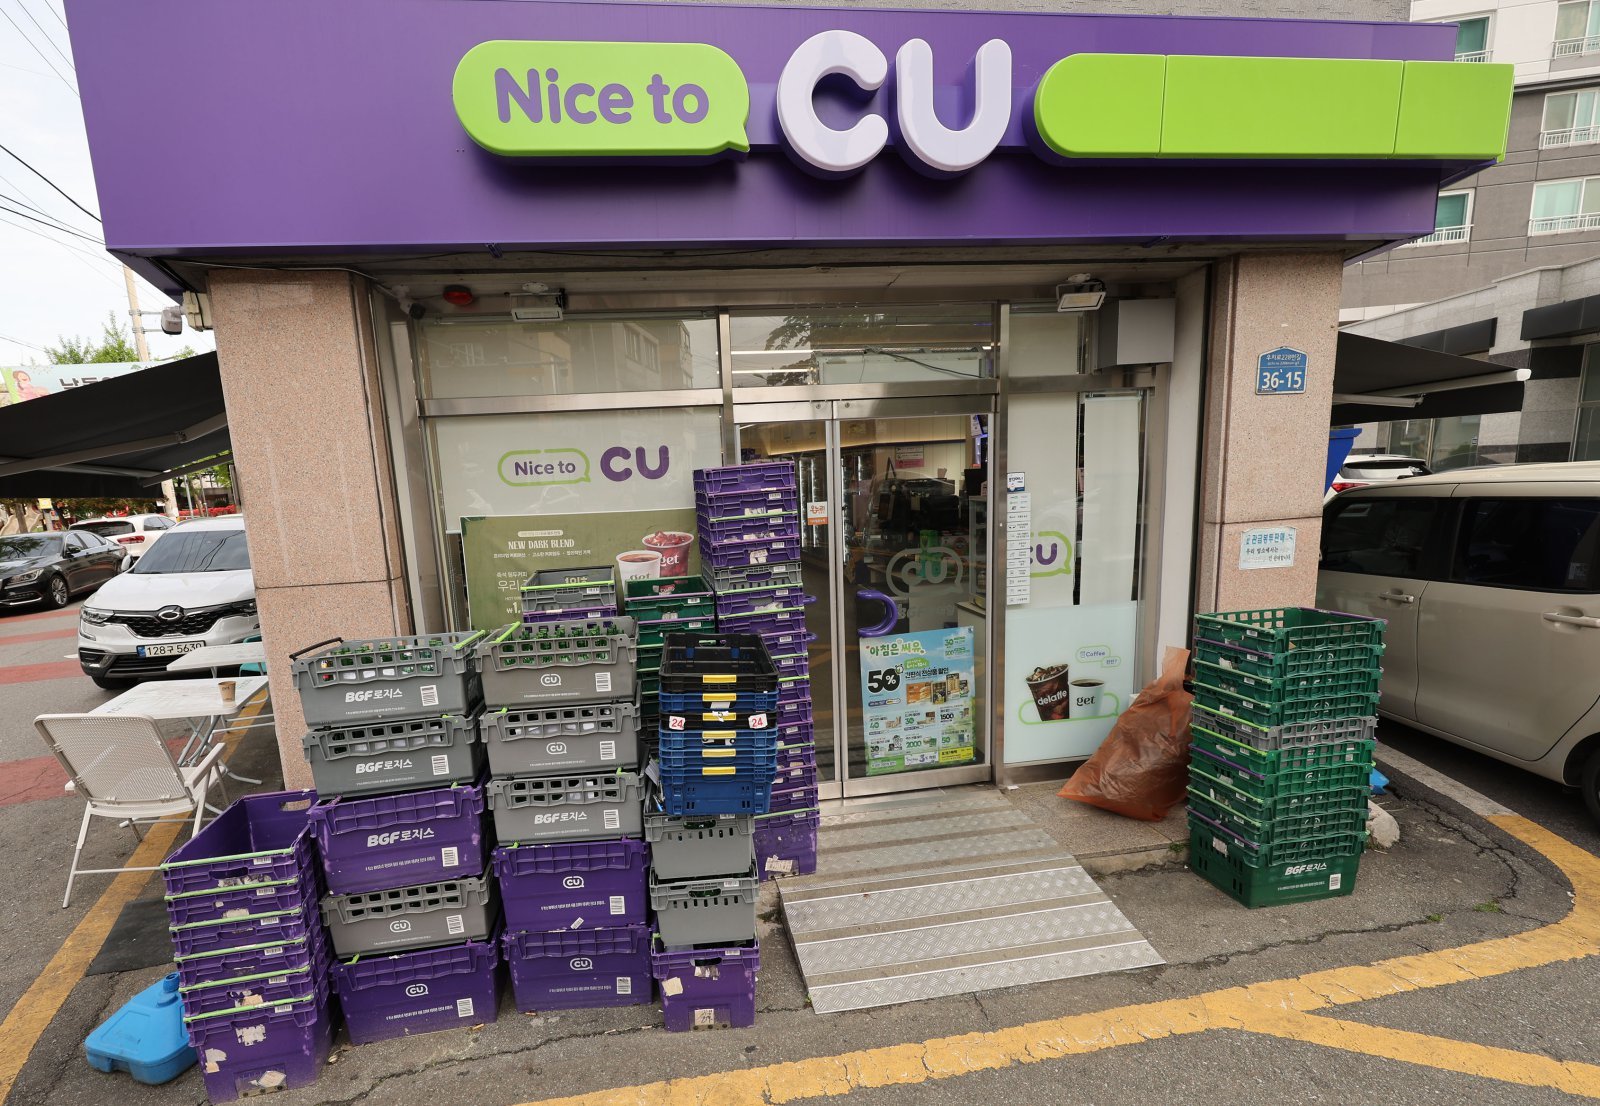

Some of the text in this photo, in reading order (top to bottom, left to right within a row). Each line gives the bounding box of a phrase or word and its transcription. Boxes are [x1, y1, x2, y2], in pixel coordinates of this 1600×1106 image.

[494, 30, 1012, 172] Nice to CU
[1261, 371, 1303, 389] 36-15
[514, 445, 670, 482] Nice to CU
[507, 538, 575, 550] NEW DARK BLEND
[660, 554, 680, 567] get
[869, 642, 922, 657] 아침은 씨유
[867, 668, 900, 693] 50%
[345, 688, 403, 703] BGF로지스
[1037, 689, 1068, 706] delaffe
[1076, 695, 1096, 707] get
[671, 718, 684, 729] 24
[751, 716, 764, 728] 24
[355, 758, 413, 774] BGF로지스
[534, 811, 588, 825] BGF로지스
[366, 827, 435, 847] BGF로지스
[1284, 862, 1328, 876] BGF로지스
